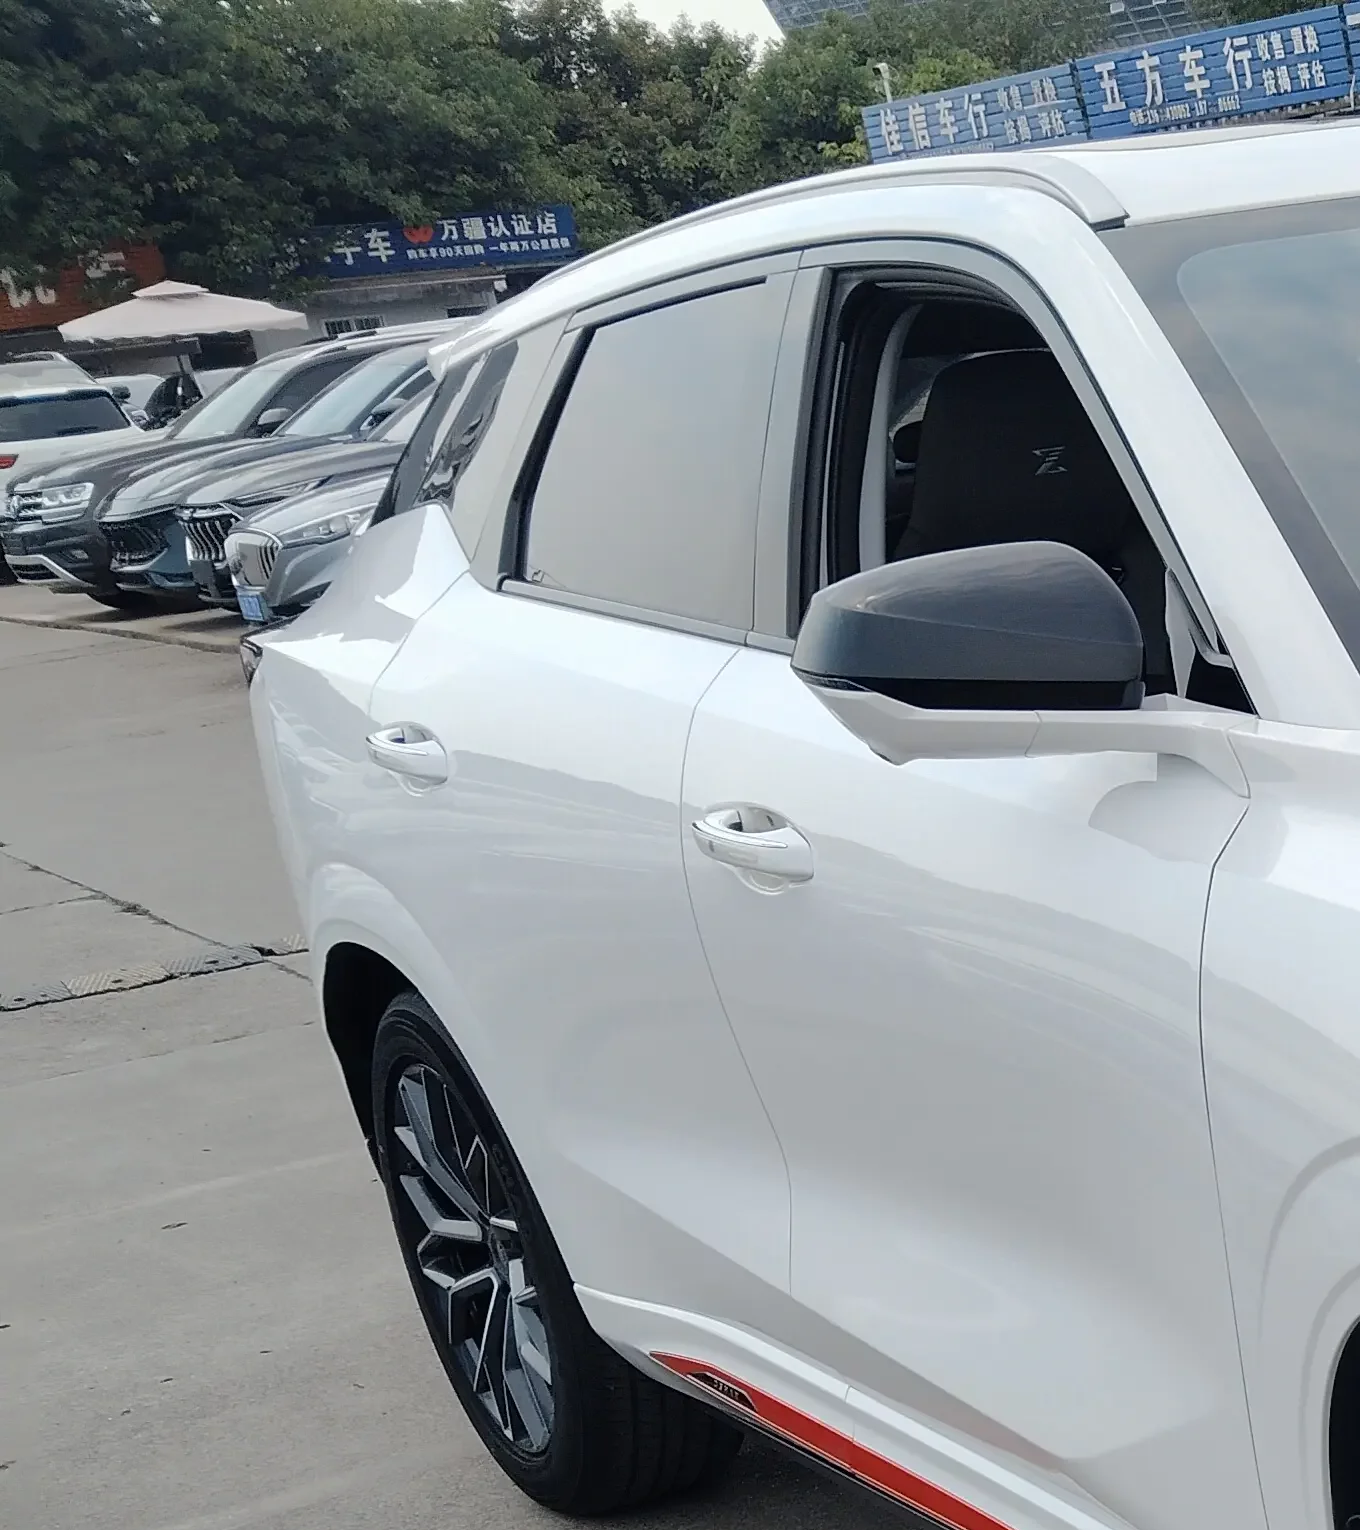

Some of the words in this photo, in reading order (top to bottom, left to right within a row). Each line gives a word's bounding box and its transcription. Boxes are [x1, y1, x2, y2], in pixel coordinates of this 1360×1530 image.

[1094, 36, 1253, 113] 五方车行
[880, 92, 989, 155] 佳信车行
[436, 212, 559, 242] 万疆认证店
